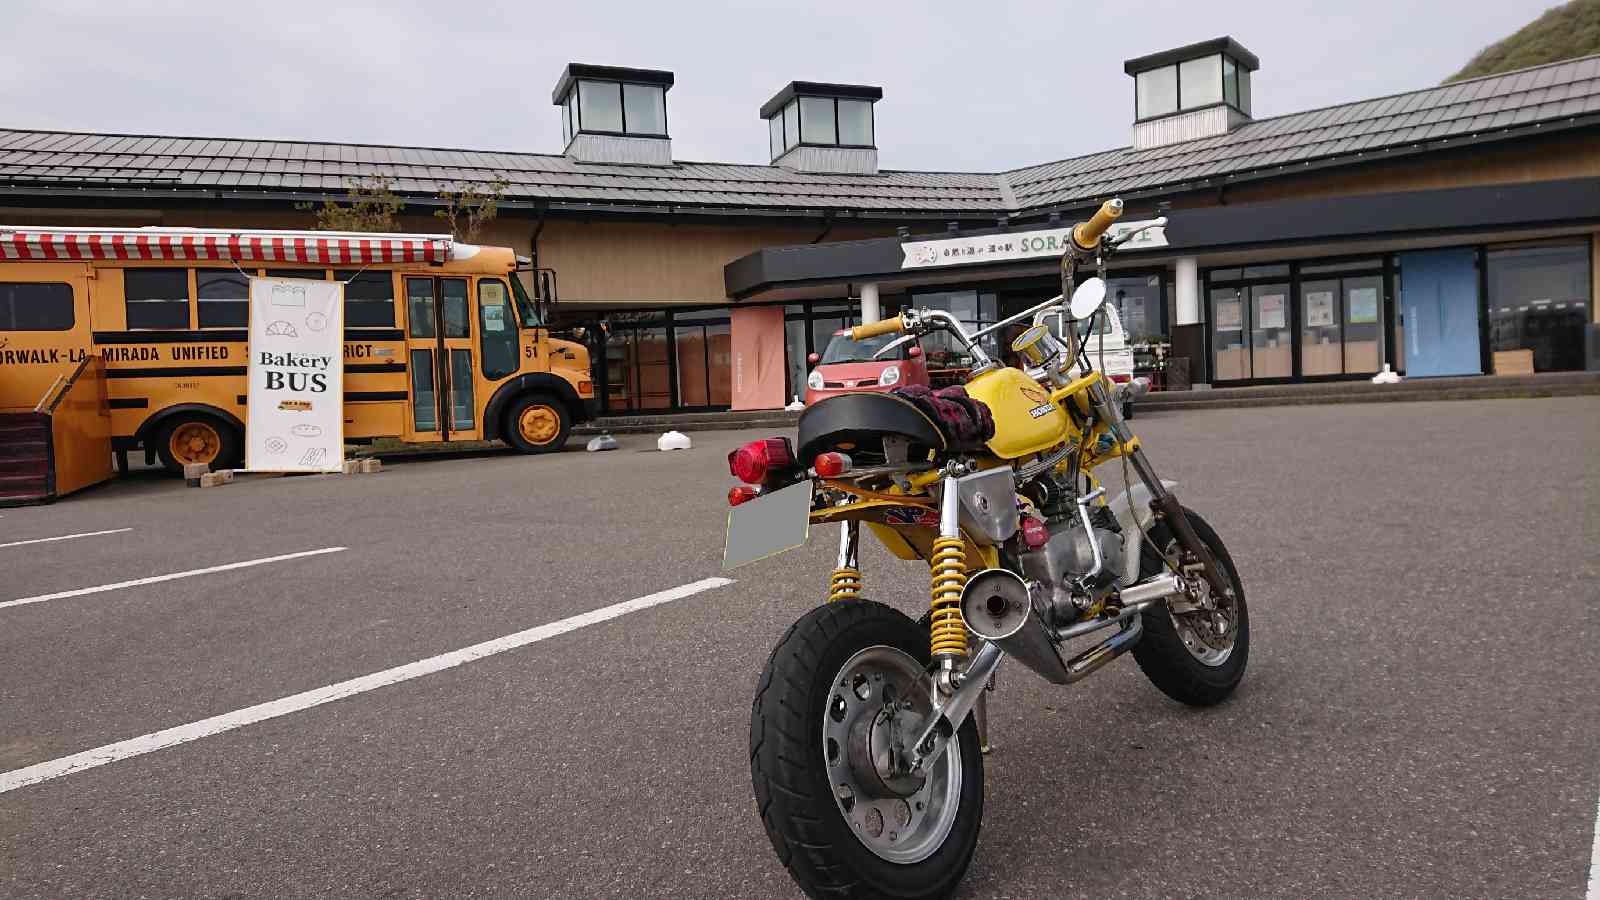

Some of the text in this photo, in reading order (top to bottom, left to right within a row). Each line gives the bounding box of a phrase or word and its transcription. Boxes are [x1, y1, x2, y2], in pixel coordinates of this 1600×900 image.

[101, 347, 160, 362] MIRADA
[172, 346, 229, 361] UNIFIED
[343, 344, 373, 358] RICT
[260, 351, 331, 370] Bakery
[525, 345, 538, 359] 51
[265, 370, 327, 393] BUS
